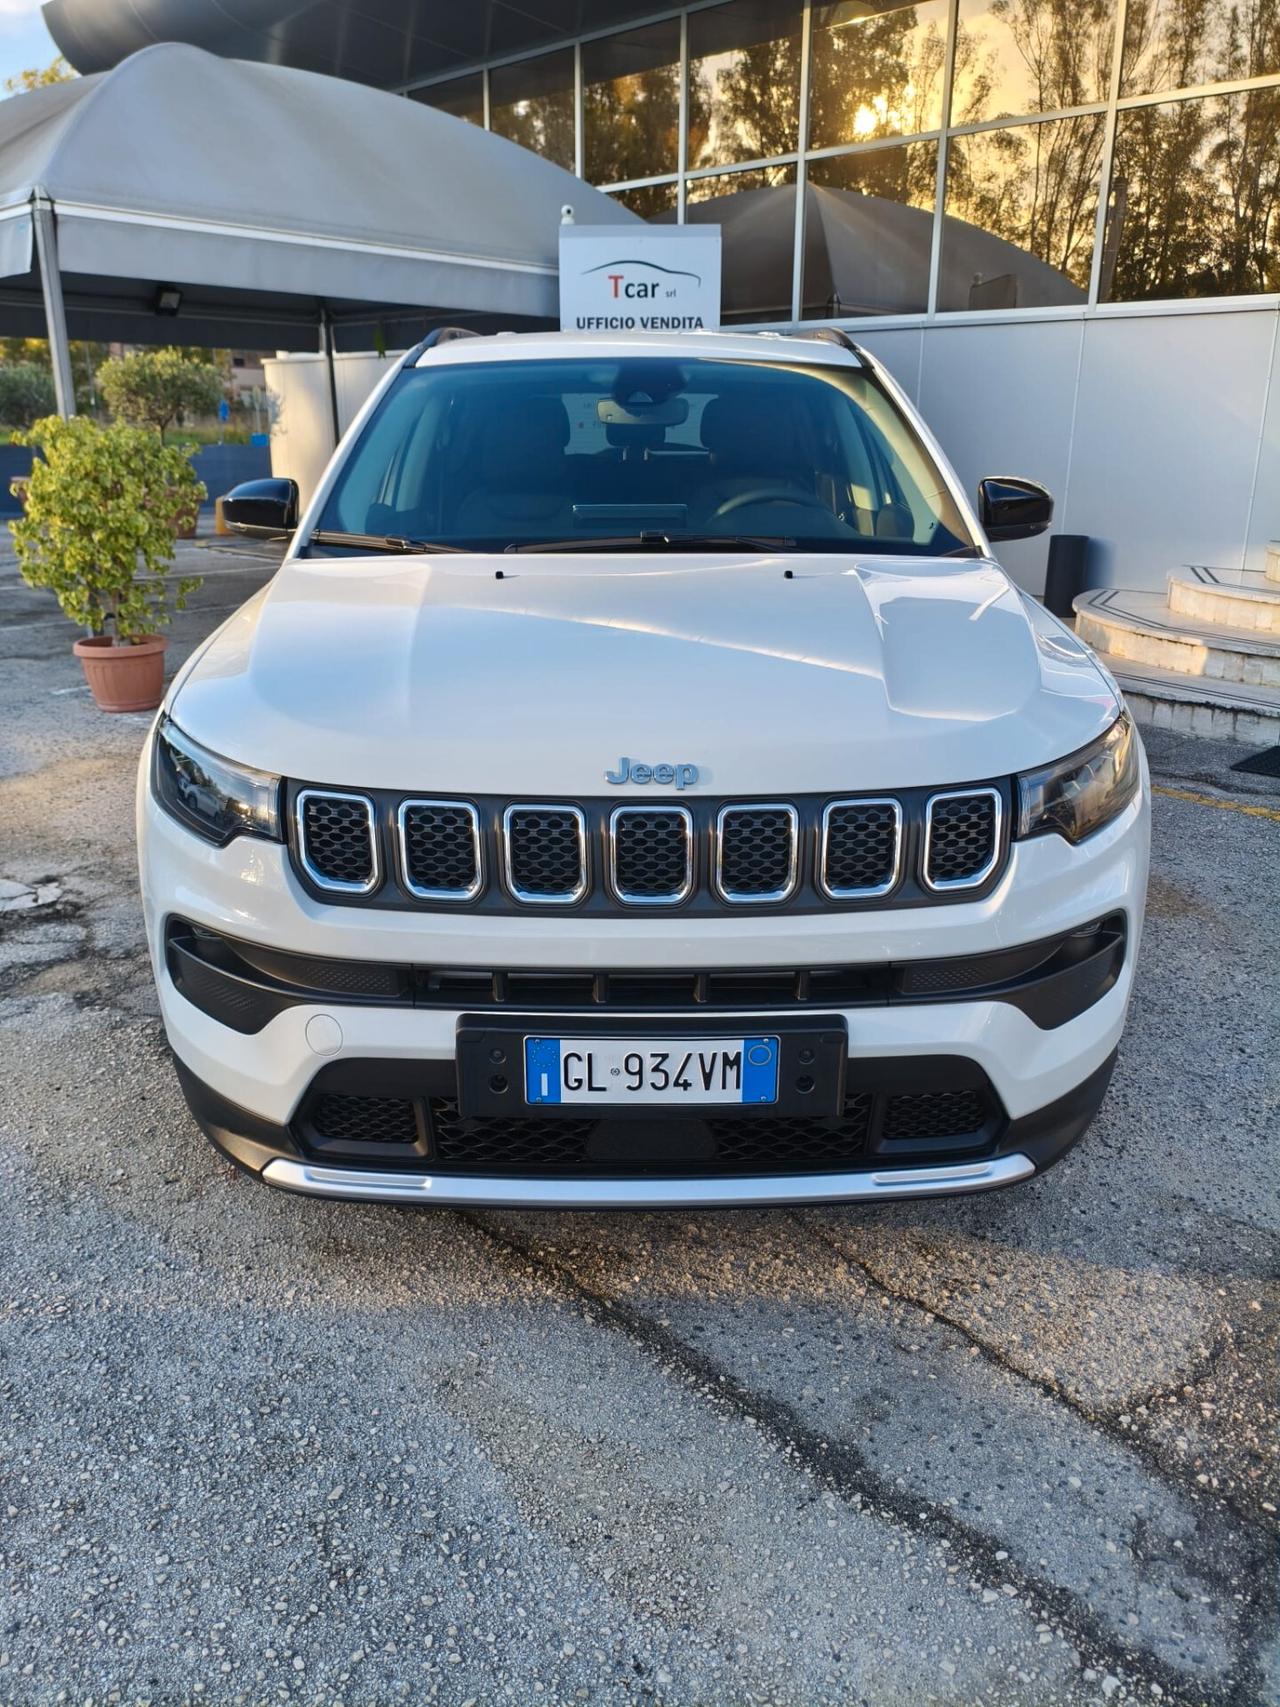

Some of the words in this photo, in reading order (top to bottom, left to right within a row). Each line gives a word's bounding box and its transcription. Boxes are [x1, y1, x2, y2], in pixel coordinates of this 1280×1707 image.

[608, 275, 660, 299] Tcar
[666, 289, 677, 298] srl
[576, 316, 635, 329] UFFICIO
[640, 316, 704, 329] VENDITA
[605, 757, 699, 791] Jeep
[563, 1052, 608, 1092] GL
